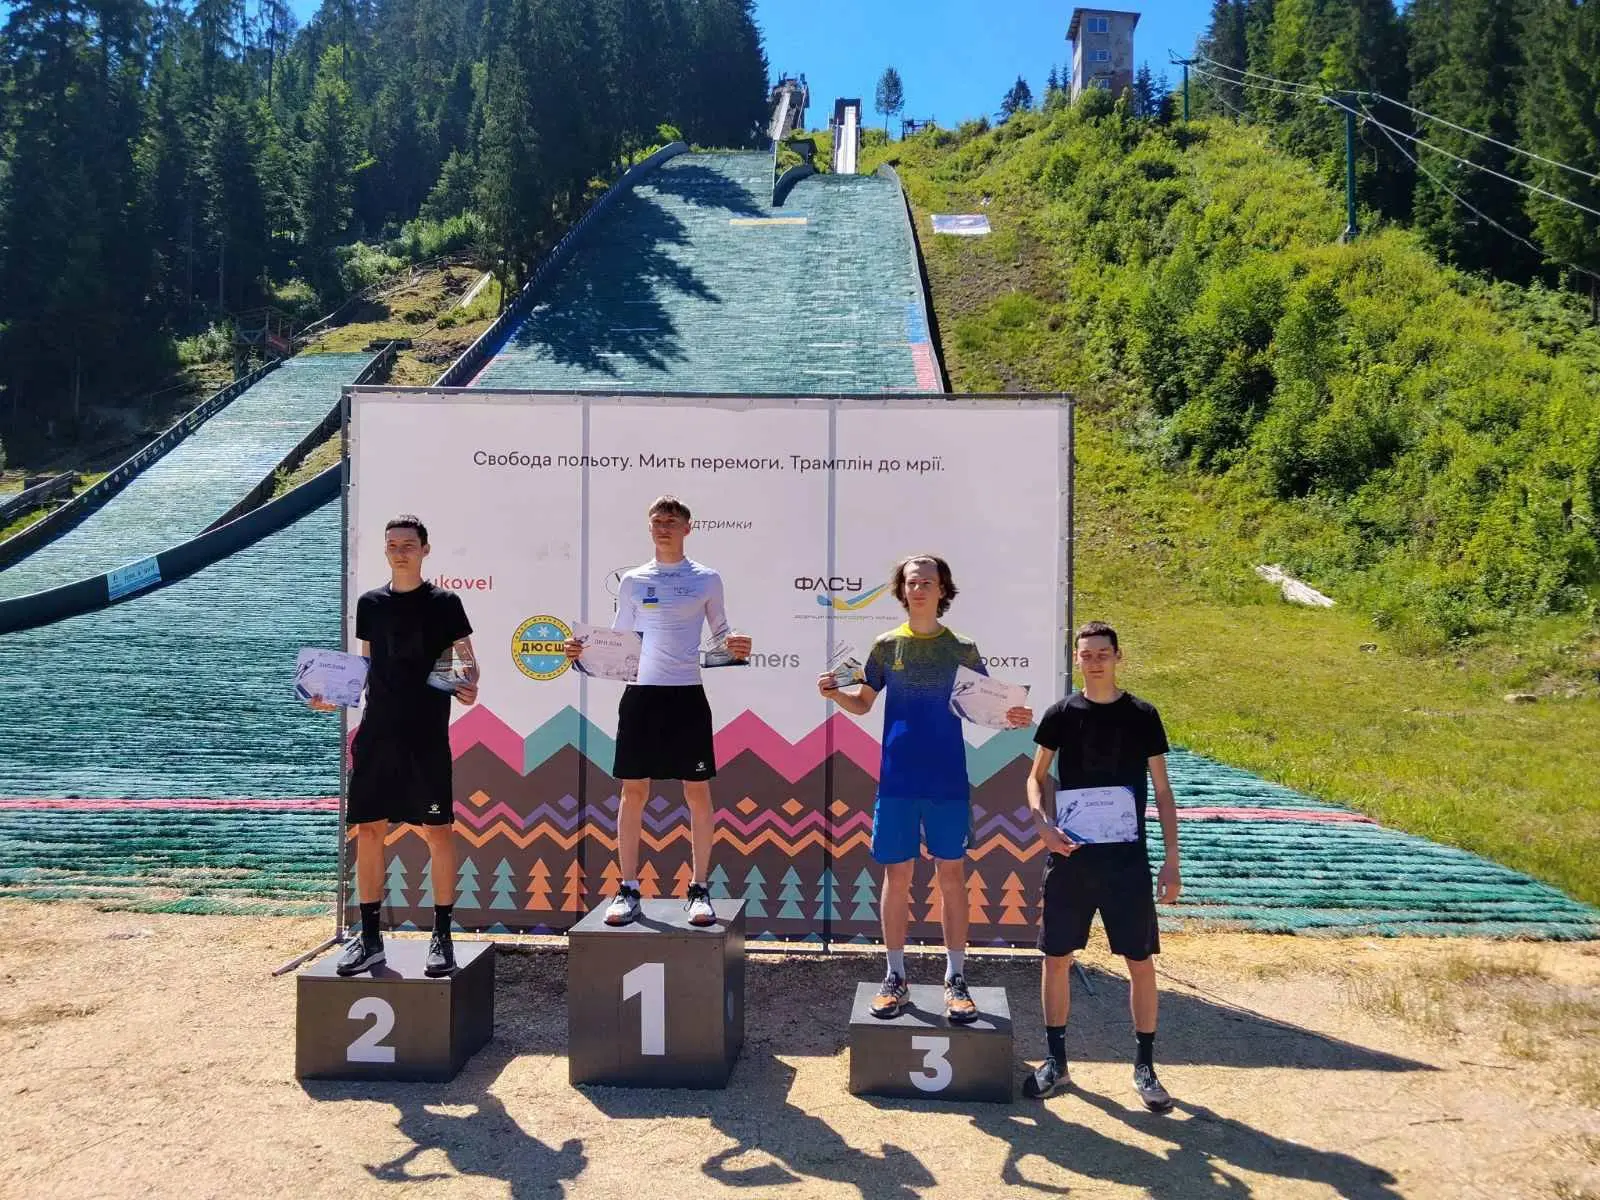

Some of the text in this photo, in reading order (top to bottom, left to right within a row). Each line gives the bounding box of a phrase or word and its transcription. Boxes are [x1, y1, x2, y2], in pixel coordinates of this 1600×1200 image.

[473, 450, 945, 475] Свобода польоту. Мить перемоги. Трамплін до мрії.
[690, 519, 752, 532] дтримки
[520, 642, 565, 653] ДЮСШ
[622, 962, 665, 1055] 1
[346, 996, 395, 1063] 2
[908, 1036, 953, 1092] 3
